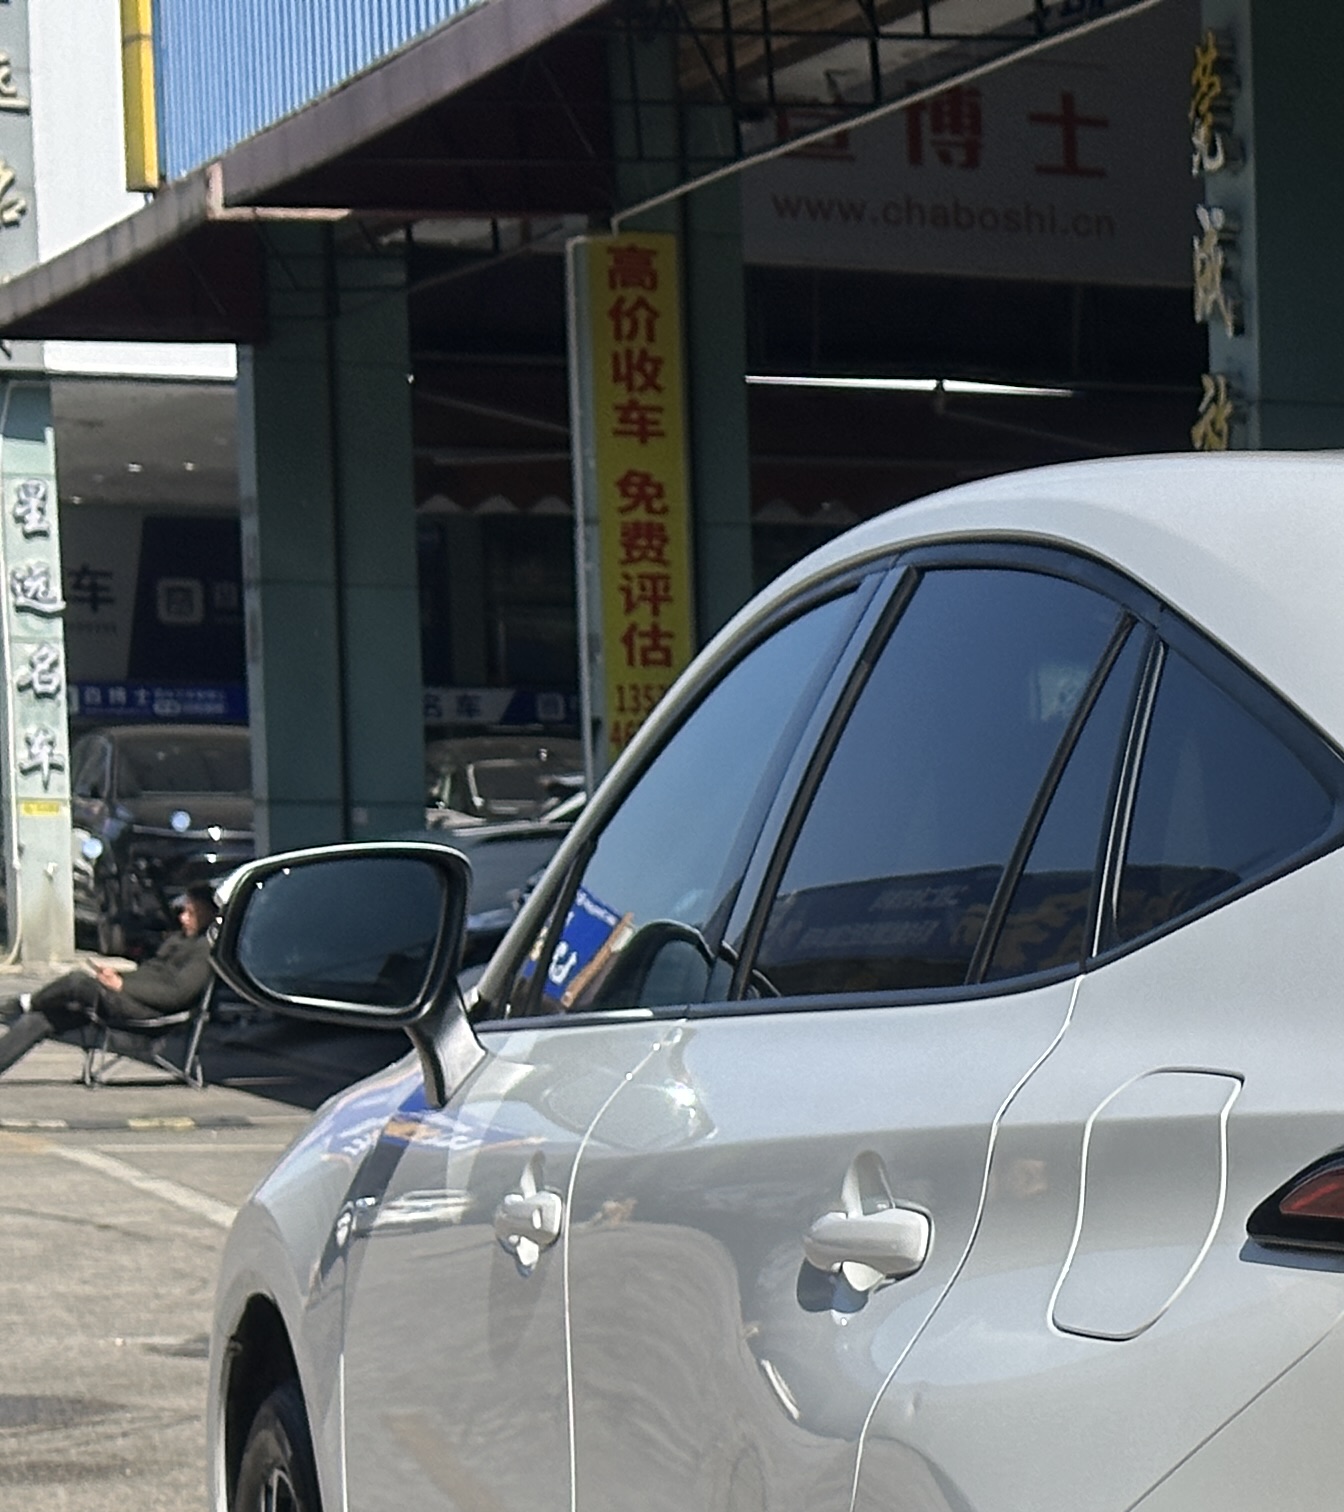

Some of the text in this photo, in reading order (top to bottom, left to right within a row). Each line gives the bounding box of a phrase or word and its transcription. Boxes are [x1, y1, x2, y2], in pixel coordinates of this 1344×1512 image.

[770, 191, 1116, 239] www.chaboshi.cn
[606, 246, 676, 669] 高价收车 免费评估
